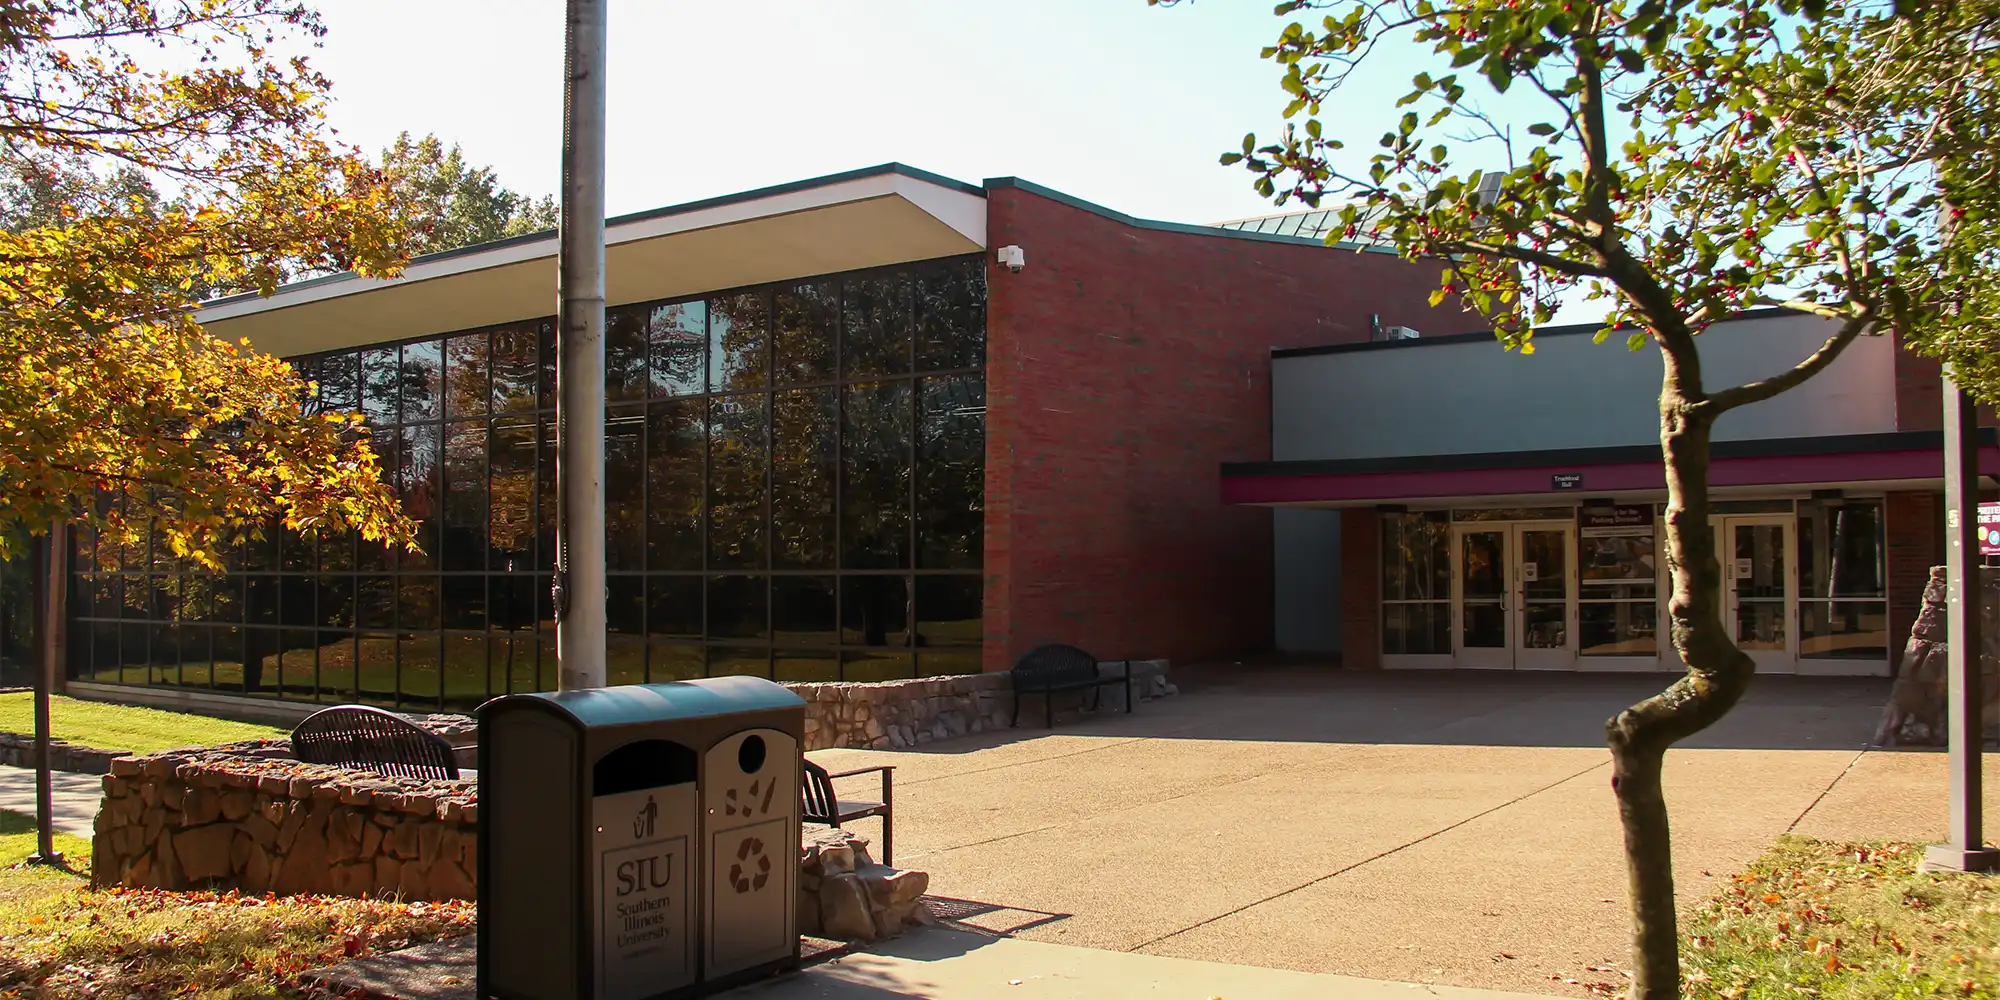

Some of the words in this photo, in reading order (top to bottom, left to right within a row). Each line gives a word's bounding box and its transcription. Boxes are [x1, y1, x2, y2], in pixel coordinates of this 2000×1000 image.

[616, 853, 673, 896] SIU
[616, 896, 671, 919] Southern
[624, 911, 666, 932] Illinois
[617, 926, 671, 948] University
